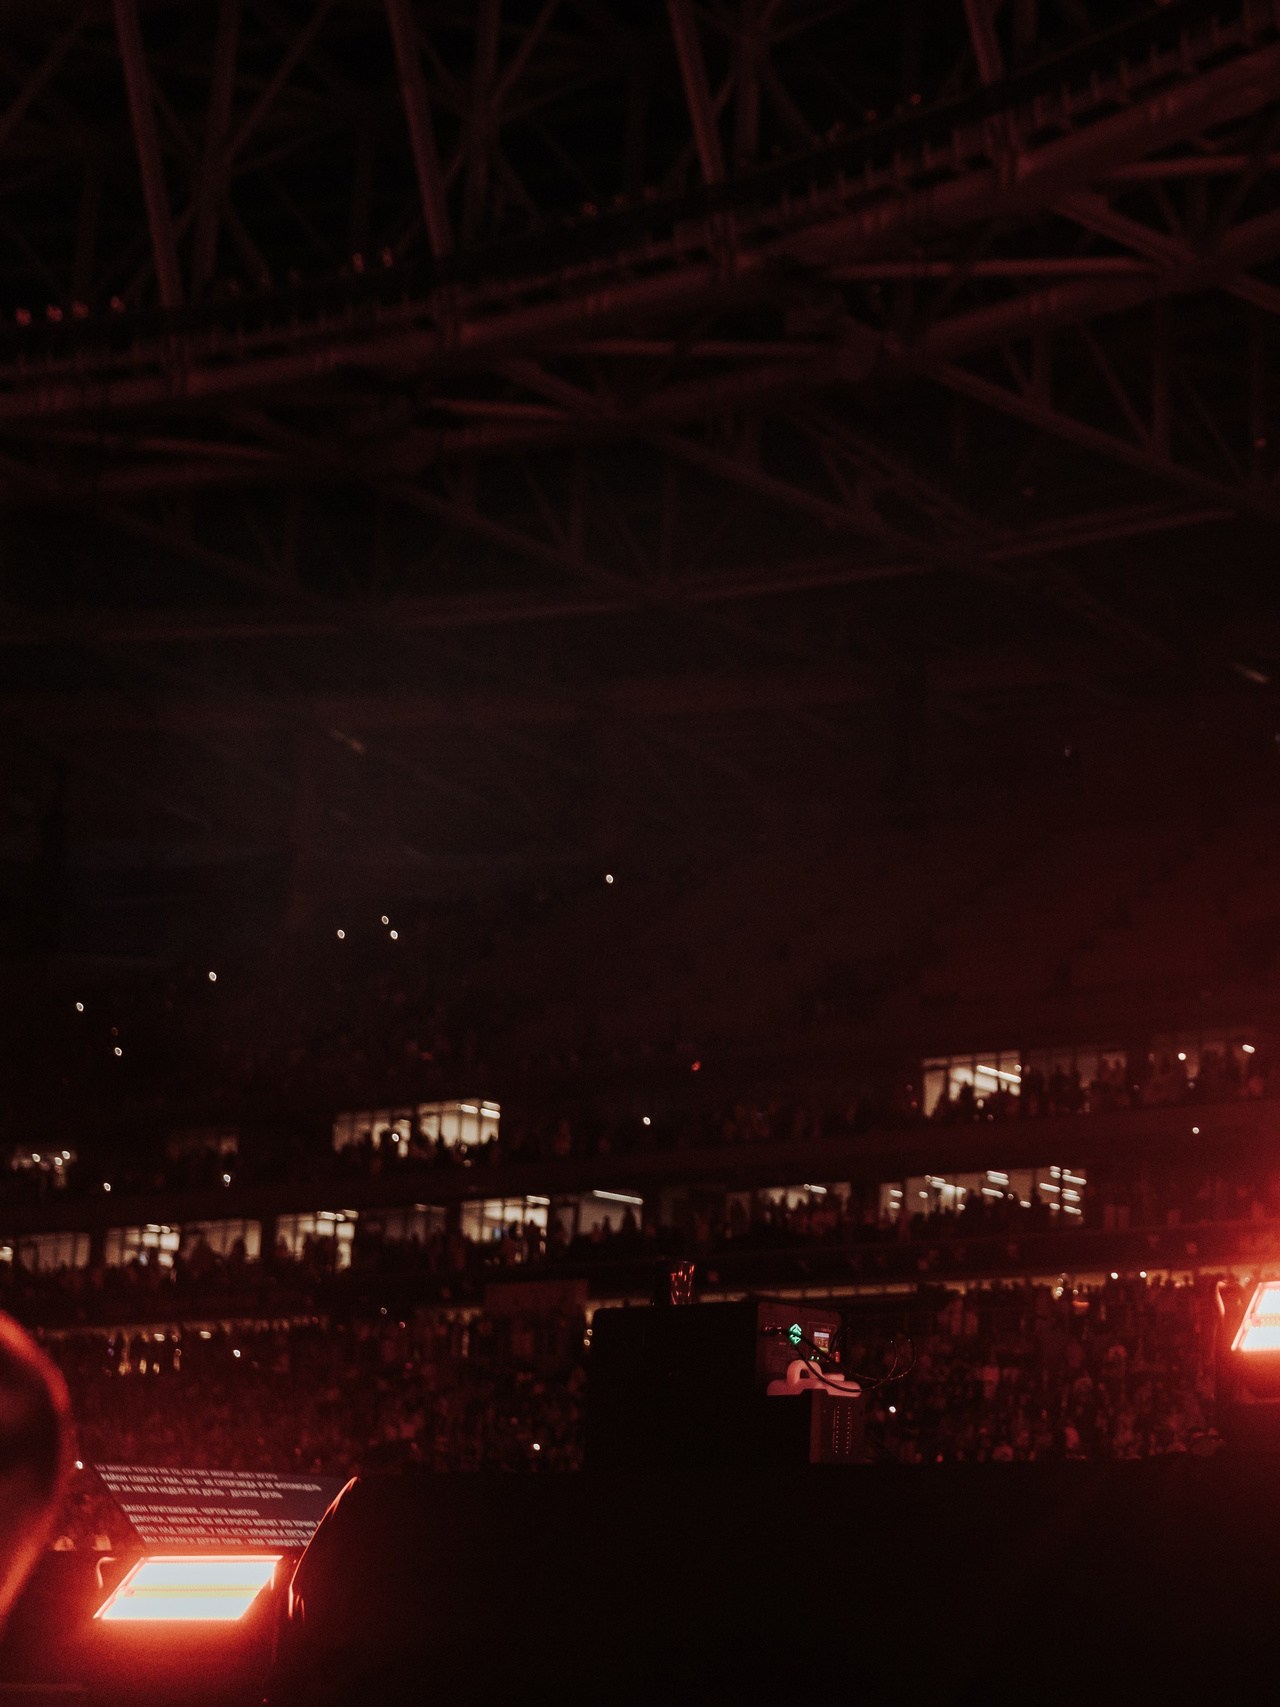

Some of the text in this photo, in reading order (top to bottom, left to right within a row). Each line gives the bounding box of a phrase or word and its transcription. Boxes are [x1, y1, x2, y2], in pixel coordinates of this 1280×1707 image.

[100, 1473, 129, 1482] РАЙОН
[155, 1476, 162, 1484] С
[181, 1477, 200, 1485] ОНА
[203, 1478, 214, 1486] НЕ
[256, 1481, 265, 1489] И
[107, 1483, 121, 1492] НО
[120, 1484, 133, 1492] ЗА
[146, 1486, 160, 1494] НА
[201, 1489, 226, 1497] ДУЭЛЬ
[259, 1492, 284, 1500] ДУЭЛЬ
[121, 1504, 149, 1513] ЗАКОН
[228, 1509, 261, 1517] НЬЮТОН
[128, 1514, 168, 1523] ДЕВОЧКА,
[166, 1516, 190, 1524] МЕНЯ
[224, 1518, 253, 1526] ПРОСТО
[135, 1525, 158, 1533] НОЧЬ
[231, 1528, 249, 1536] ЕСТЬ
